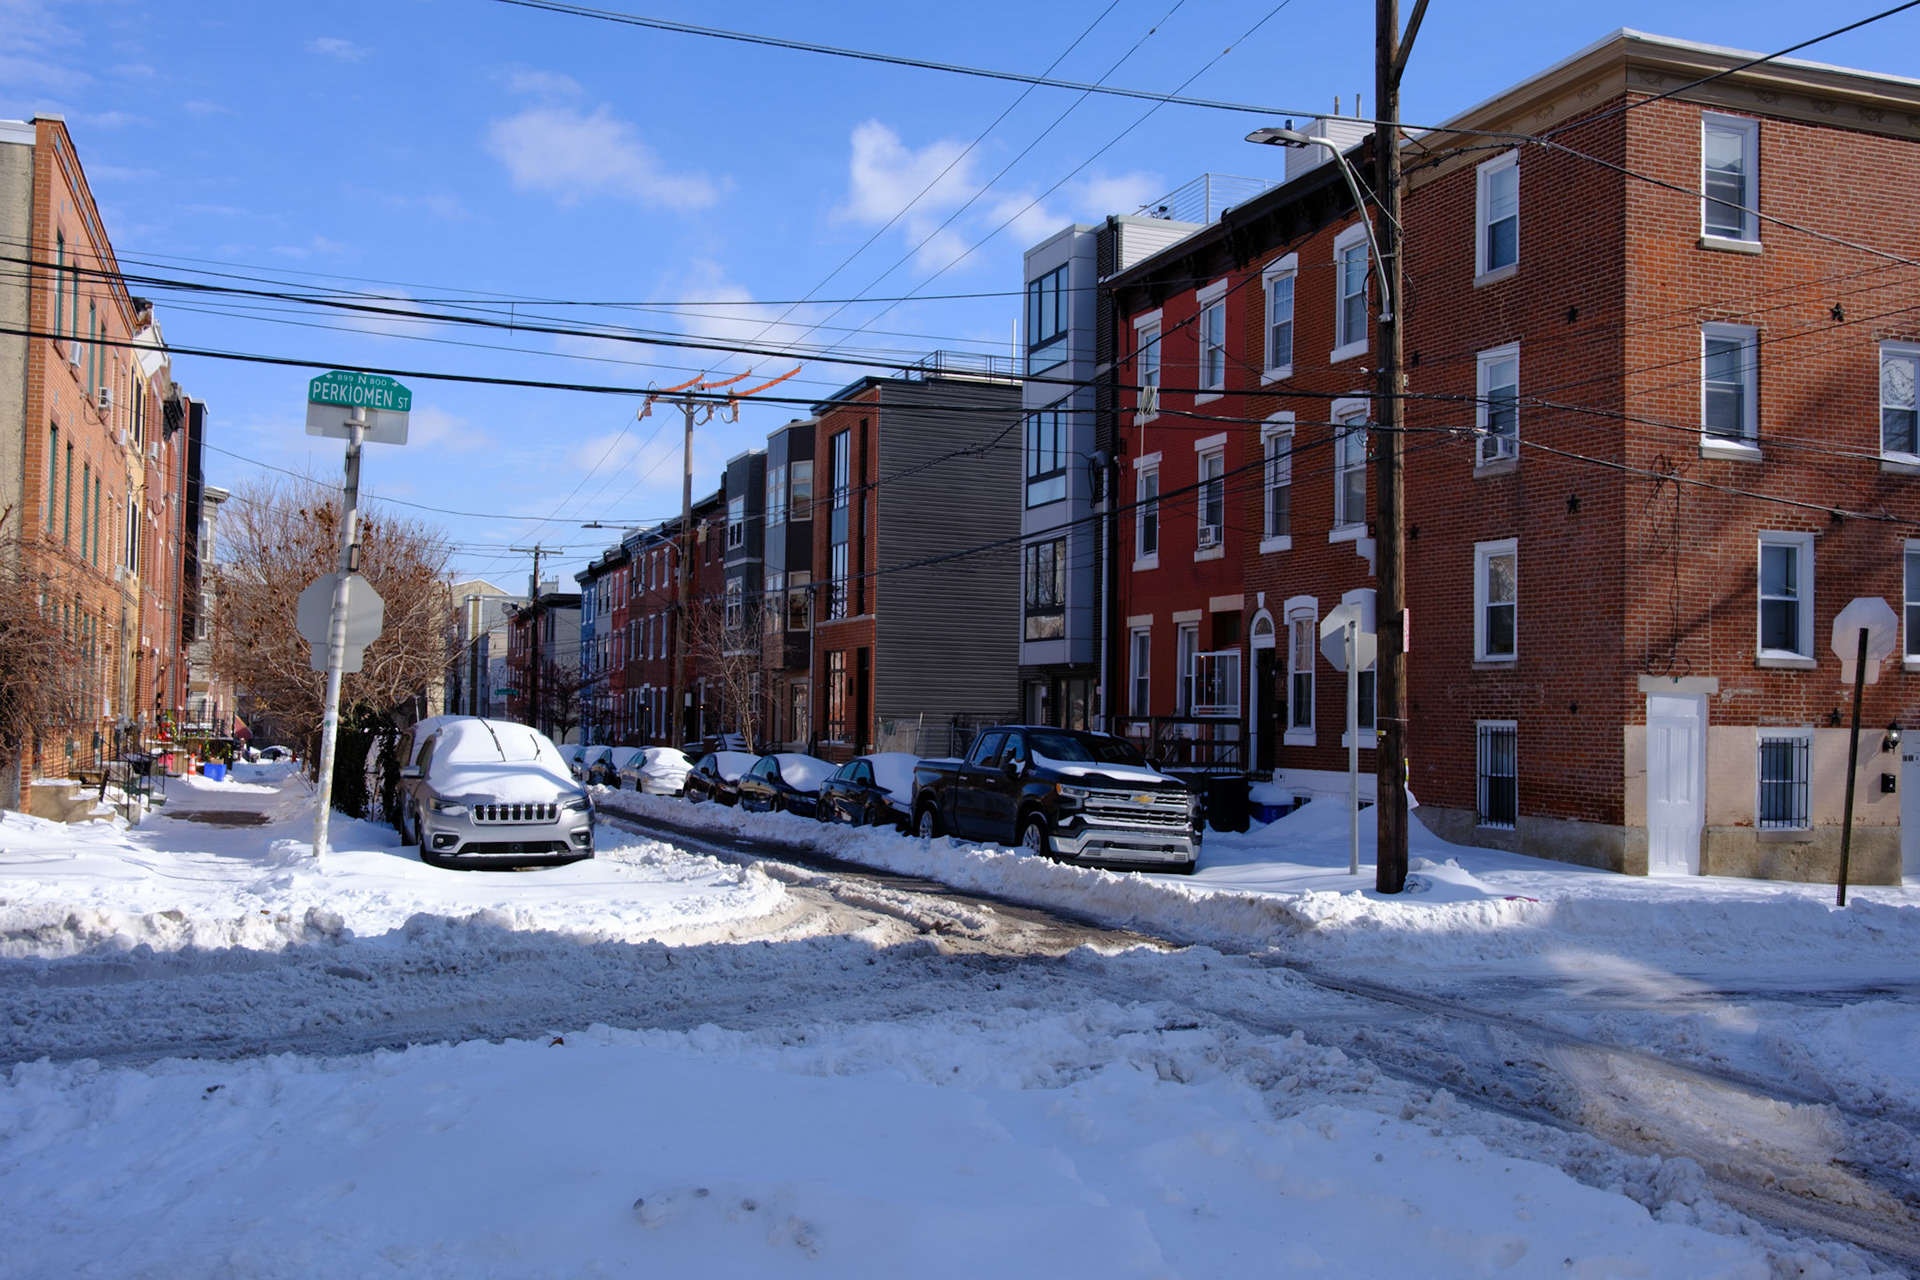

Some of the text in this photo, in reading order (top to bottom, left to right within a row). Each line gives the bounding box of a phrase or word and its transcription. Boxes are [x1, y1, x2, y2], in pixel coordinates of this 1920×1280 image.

[337, 374, 387, 386] 899 N 800
[312, 381, 409, 409] PERKIOMEN ST
